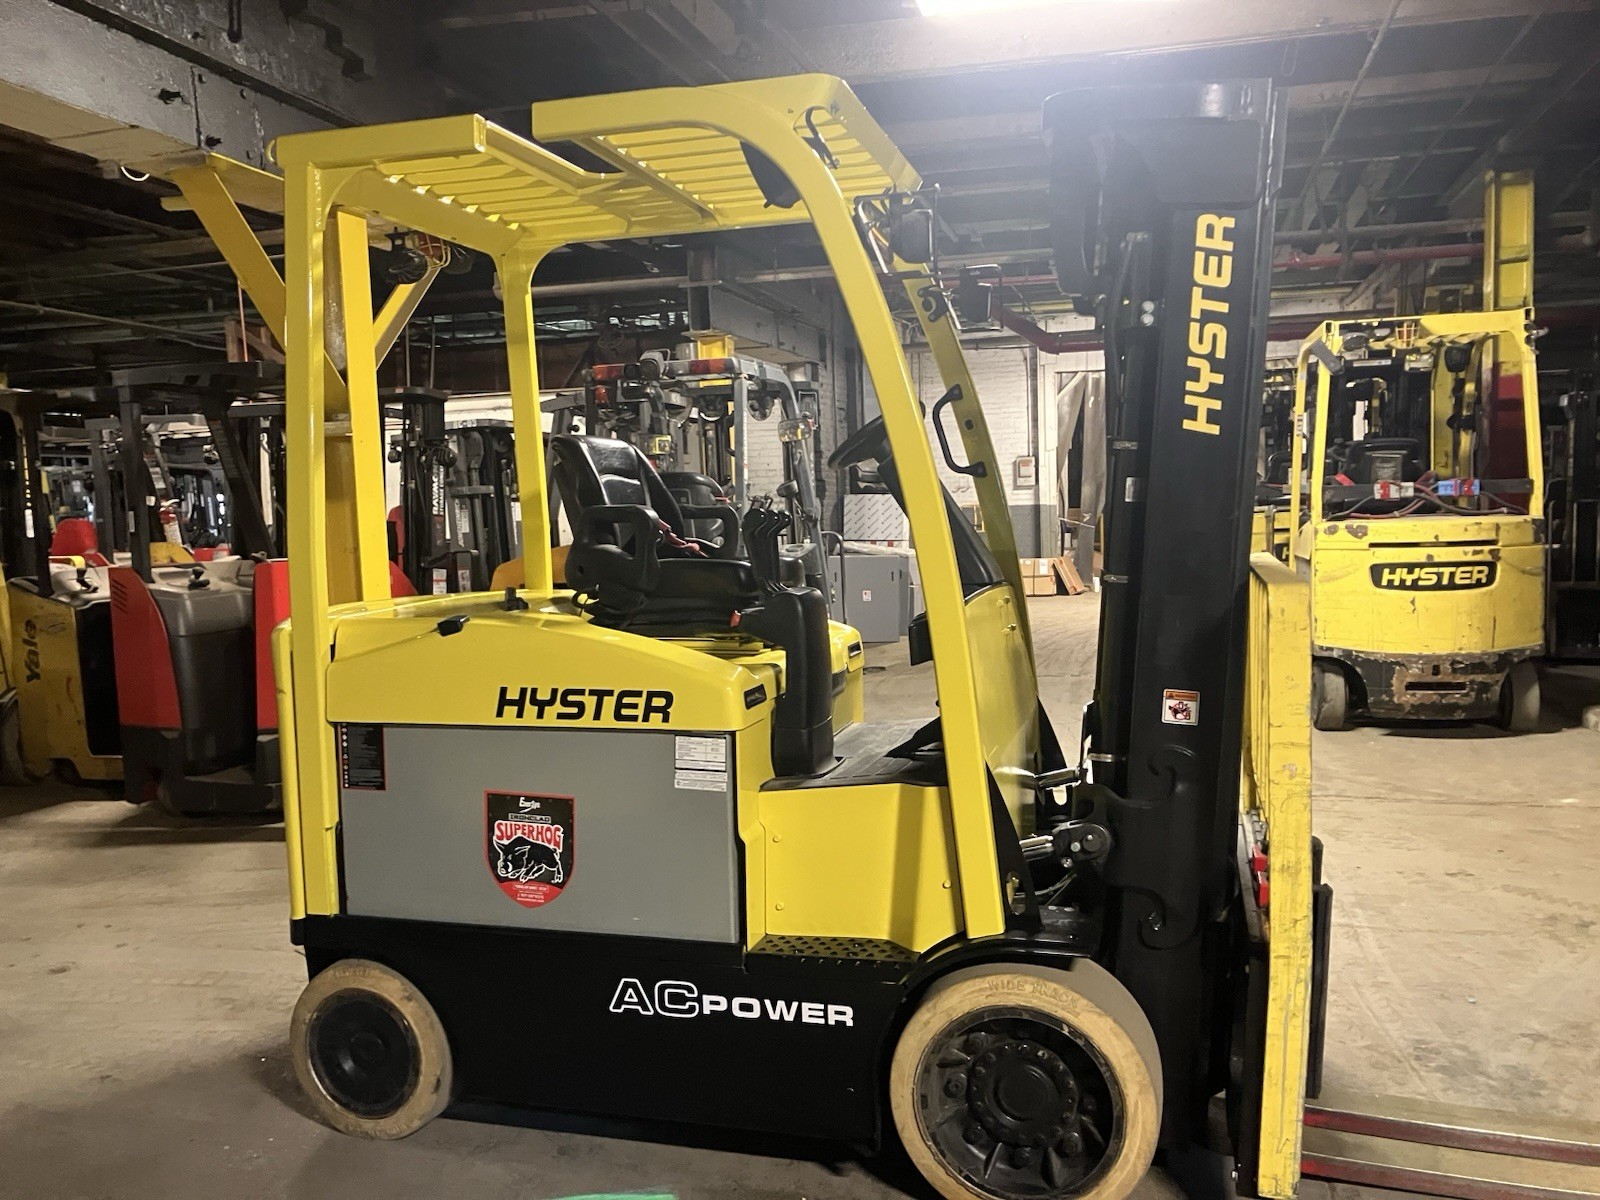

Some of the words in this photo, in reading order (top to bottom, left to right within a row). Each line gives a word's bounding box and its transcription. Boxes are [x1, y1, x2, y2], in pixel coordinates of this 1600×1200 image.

[1182, 214, 1236, 436] HYSTER
[1381, 565, 1489, 586] HYSTER
[24, 619, 40, 683] Yale
[495, 686, 674, 723] HYSTER
[495, 821, 562, 850] SUPERHOG
[988, 979, 1026, 992] WIDE
[702, 994, 854, 1027] POWER
